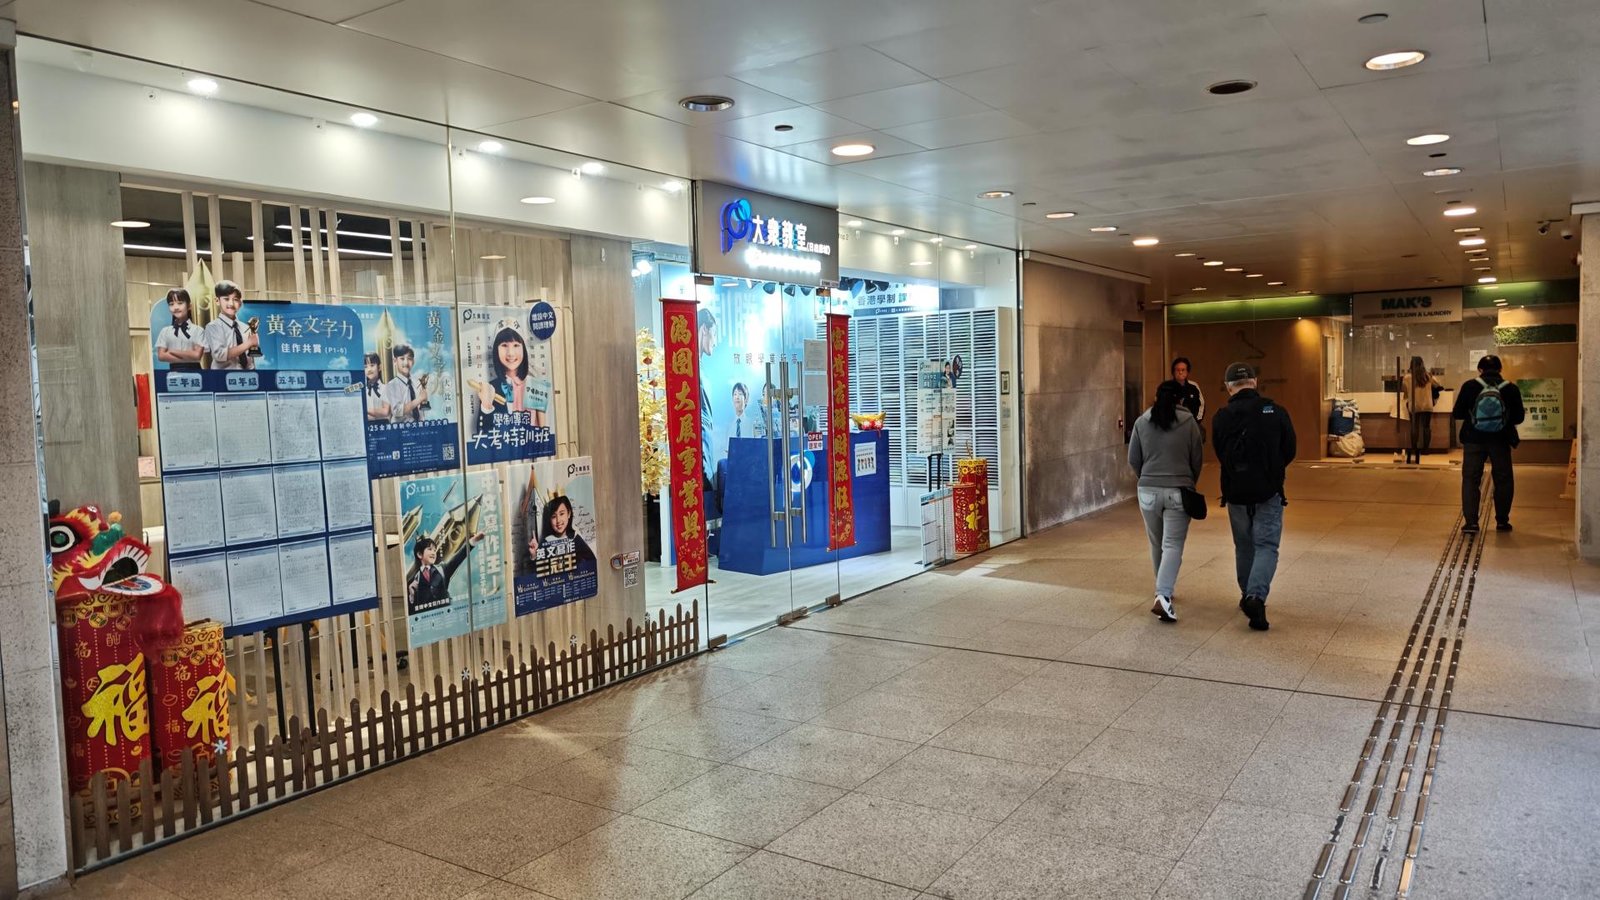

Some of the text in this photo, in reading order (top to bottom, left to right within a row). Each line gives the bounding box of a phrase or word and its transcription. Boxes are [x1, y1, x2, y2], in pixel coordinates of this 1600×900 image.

[1382, 296, 1432, 310] MAK'S
[266, 314, 353, 340] 黃金文字力
[281, 342, 322, 355] 佳作共賞
[168, 377, 201, 388] 三年級
[228, 376, 258, 387] 四年級
[278, 375, 307, 385] 五年級
[324, 375, 351, 384] 六年級
[493, 412, 531, 427] 學制專家
[473, 426, 550, 450] 大考特訓班
[536, 542, 576, 560] 英文寫作
[535, 553, 577, 578] 三冠王
